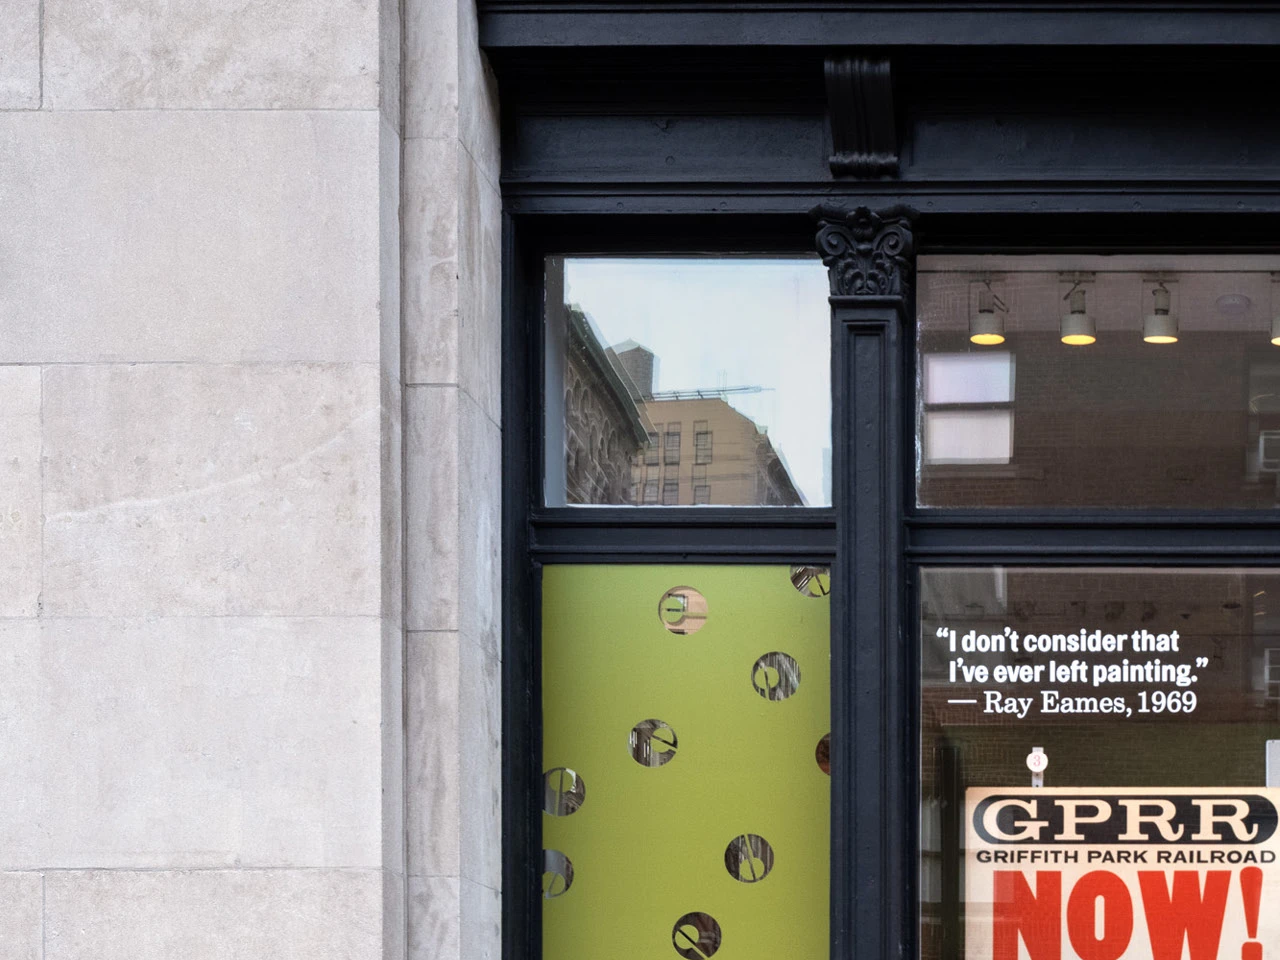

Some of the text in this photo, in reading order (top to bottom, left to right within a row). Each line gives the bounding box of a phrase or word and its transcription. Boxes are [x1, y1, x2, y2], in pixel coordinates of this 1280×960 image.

[1023, 629, 1128, 653] consider
[1131, 629, 1180, 653] that
[993, 664, 1046, 684] ever
[1049, 659, 1089, 684] left
[983, 690, 1034, 718] Ray
[1040, 690, 1133, 717] Eames,
[1137, 690, 1197, 713] 1969
[1033, 754, 1041, 767] 3
[980, 798, 1262, 842] GPRR
[975, 850, 1277, 864] GRIFFITH PARK RAILROAD
